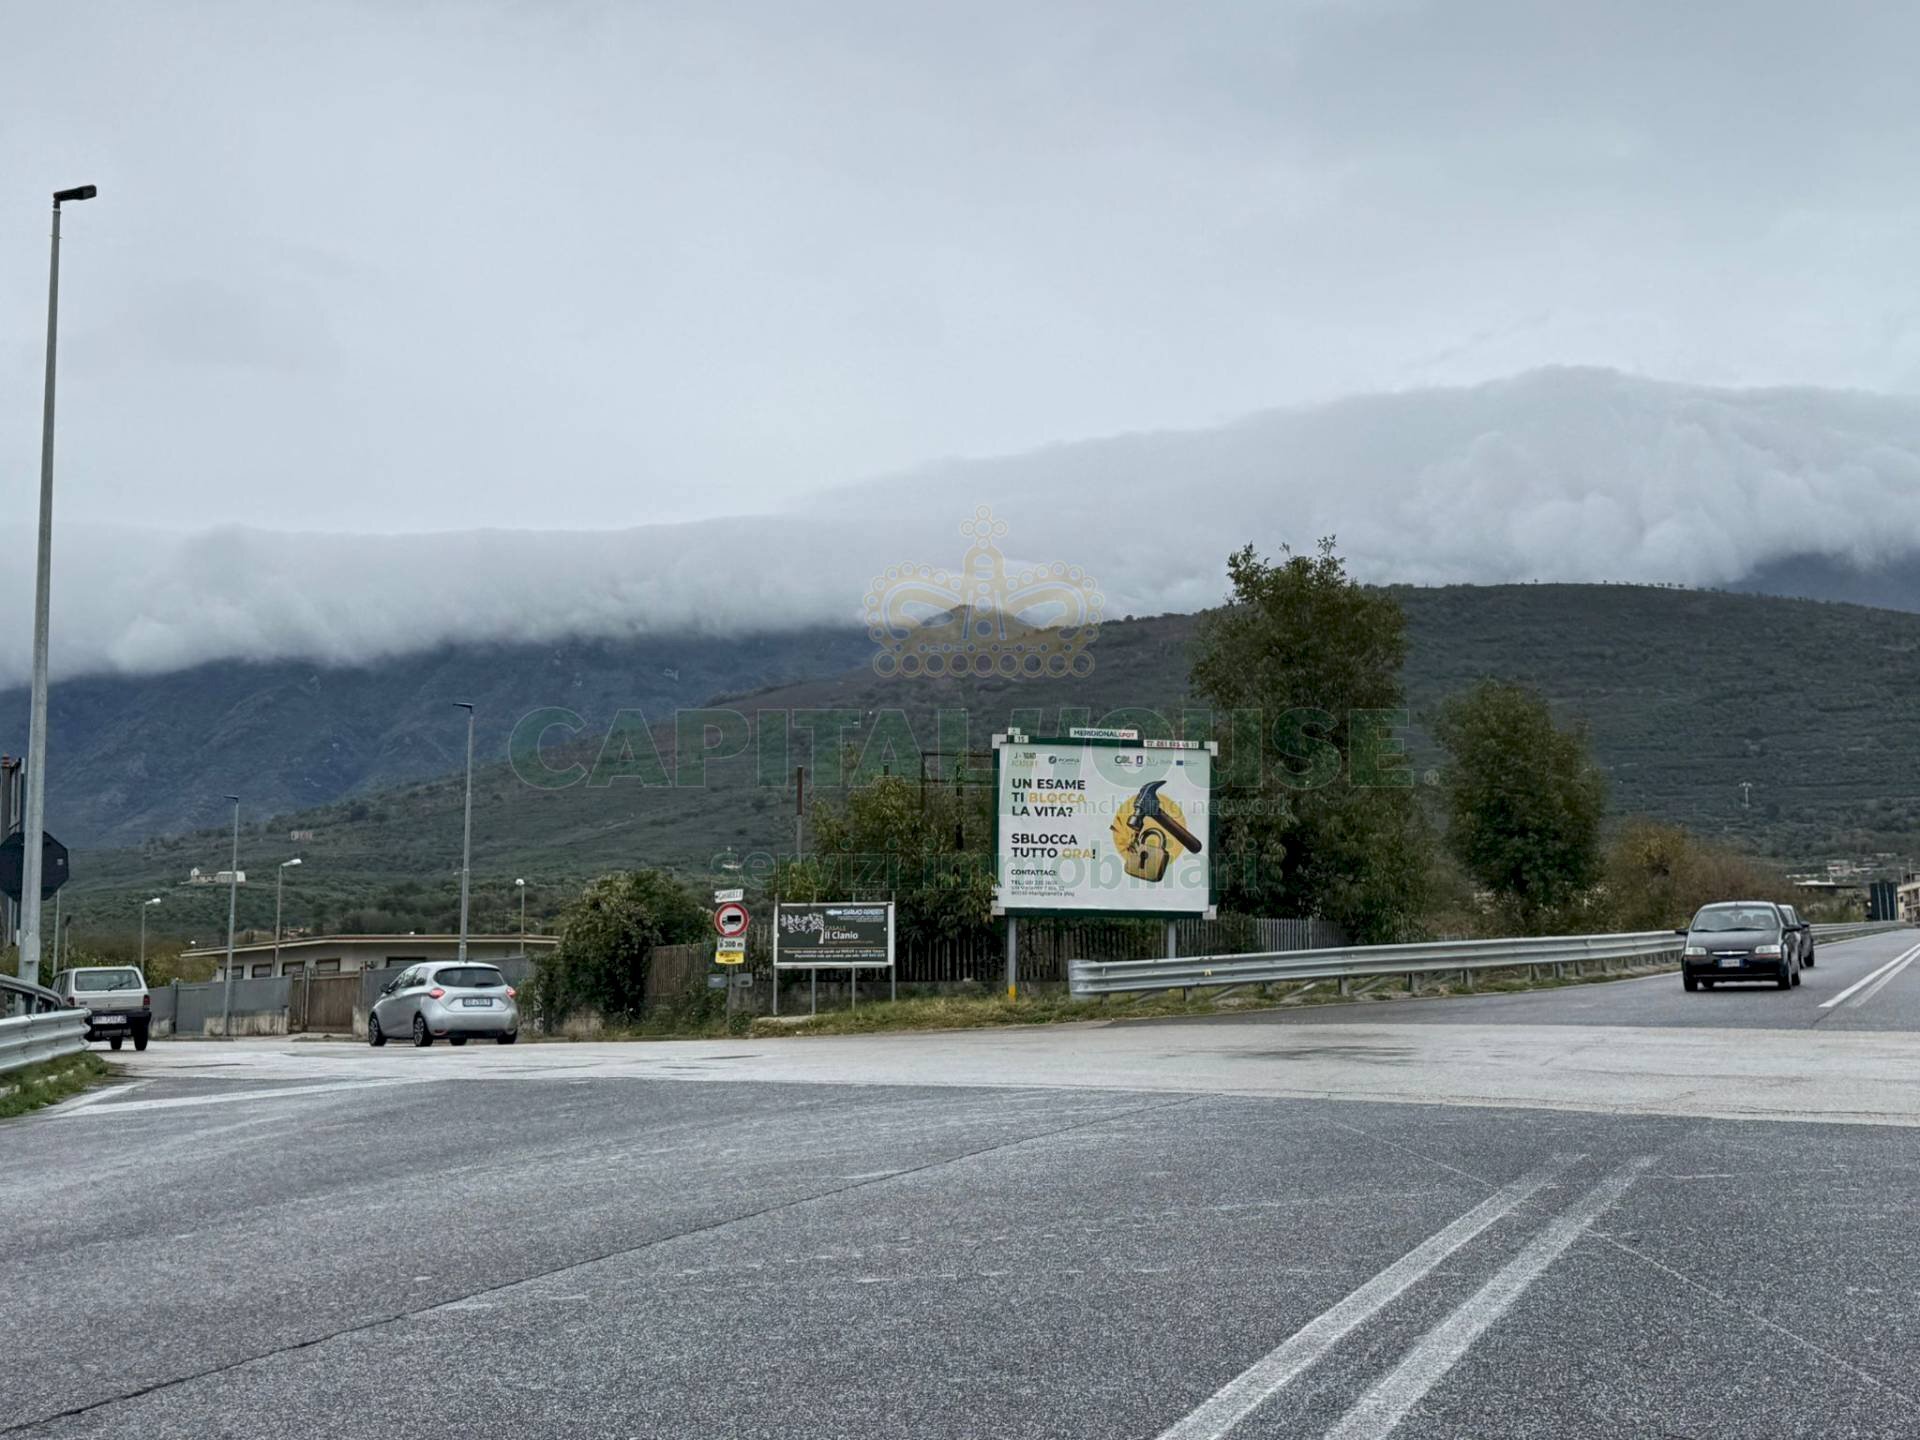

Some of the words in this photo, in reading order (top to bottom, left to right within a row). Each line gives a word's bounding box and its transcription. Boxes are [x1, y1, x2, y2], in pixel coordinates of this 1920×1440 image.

[1012, 778, 1032, 789] UN
[1037, 778, 1086, 790] ESAME
[1012, 792, 1024, 802] TI
[1029, 792, 1085, 803] BLOCCA
[1012, 806, 1030, 817] LA
[1035, 806, 1073, 817] VITA?
[1011, 833, 1078, 845] SBLOCCA
[1011, 847, 1058, 858] TUTTO
[1062, 848, 1096, 859] ORA!
